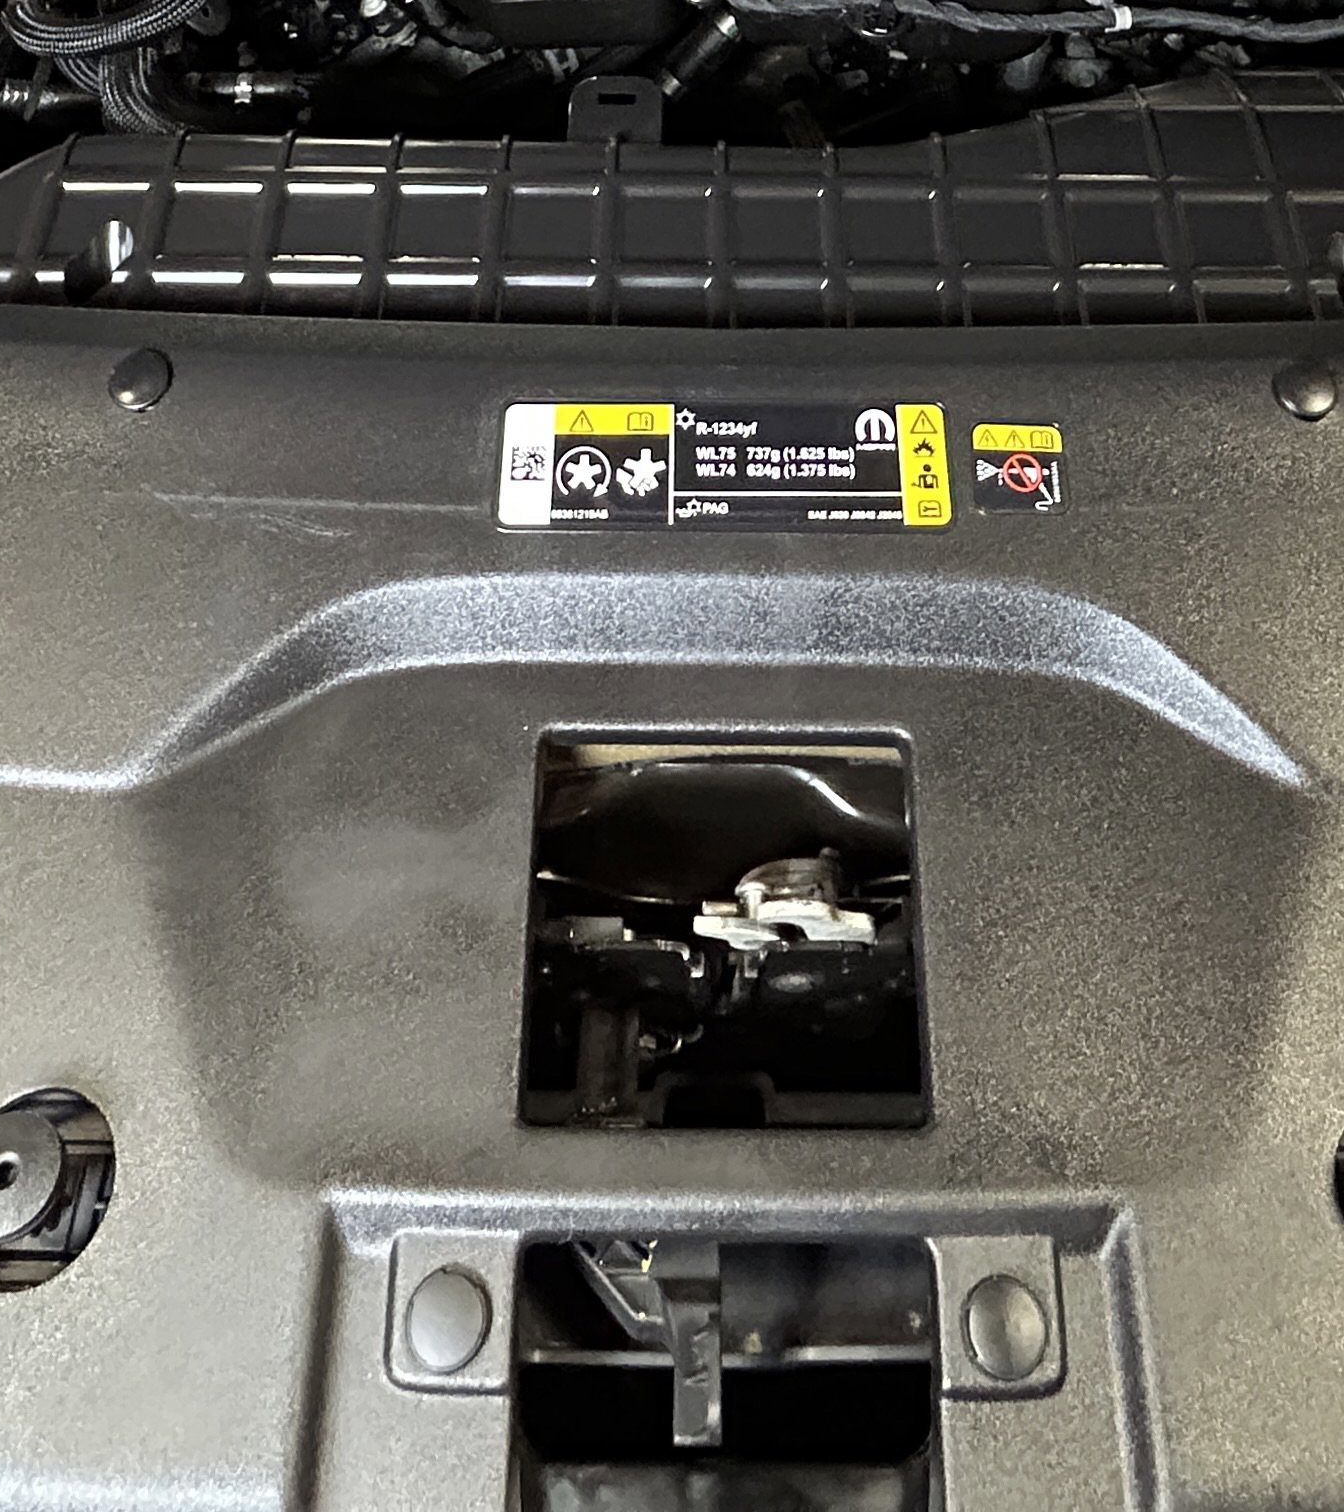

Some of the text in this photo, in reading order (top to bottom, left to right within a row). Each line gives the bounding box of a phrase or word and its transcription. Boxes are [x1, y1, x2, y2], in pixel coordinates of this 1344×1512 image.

[696, 421, 758, 439] R-1234yf
[696, 446, 736, 461] WL75
[746, 446, 781, 463] 737g
[827, 446, 855, 463] lbs)
[696, 463, 856, 480] WL74 624g (1.375 lbs)
[702, 501, 729, 515] PAG
